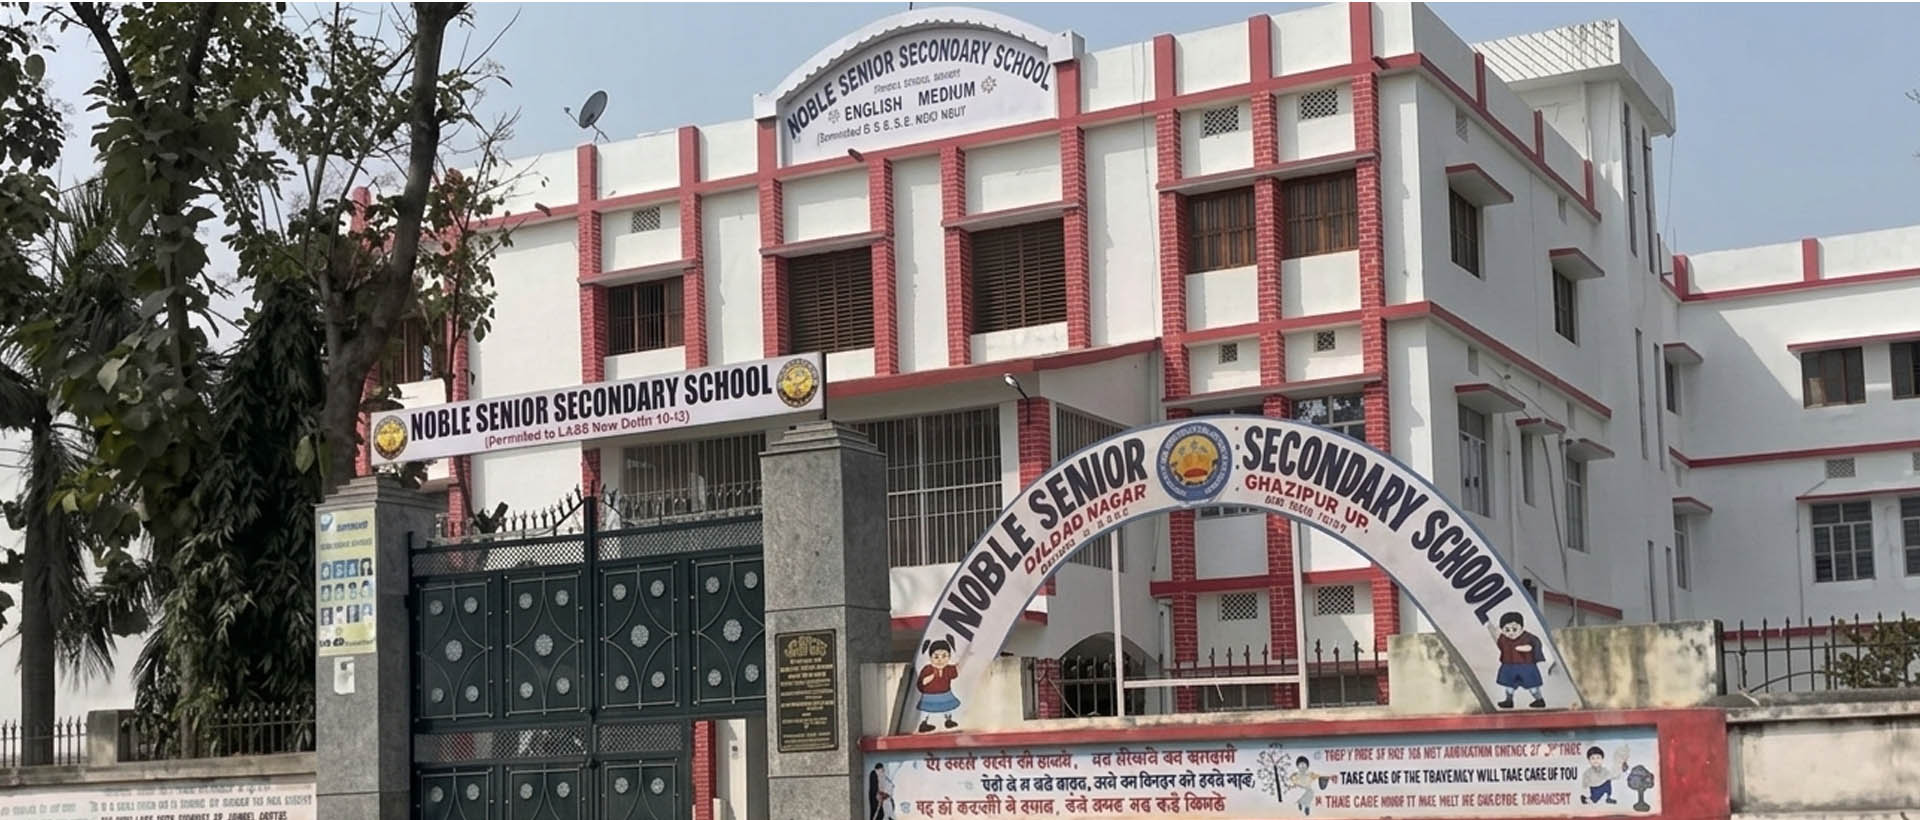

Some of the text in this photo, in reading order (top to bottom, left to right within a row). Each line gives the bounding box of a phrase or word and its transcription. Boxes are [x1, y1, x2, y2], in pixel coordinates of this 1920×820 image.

[786, 38, 1053, 140] NOBLE SENIOR SECONDARY SCHOOL
[845, 81, 976, 121] ENGLISH MEDIUM
[410, 363, 773, 442] NOBLE SENIOR SECONDARY SCHOOL
[1087, 484, 1147, 522] NAGAR
[1245, 474, 1338, 514] GHAZIPUR
[938, 512, 1035, 642] NOBLE
[1028, 438, 1148, 530] SENIOR
[1242, 425, 1428, 532] SECONDARY
[1411, 510, 1513, 625] SCHOOL
[1404, 769, 1421, 784] THE
[1476, 768, 1499, 783] WILL
